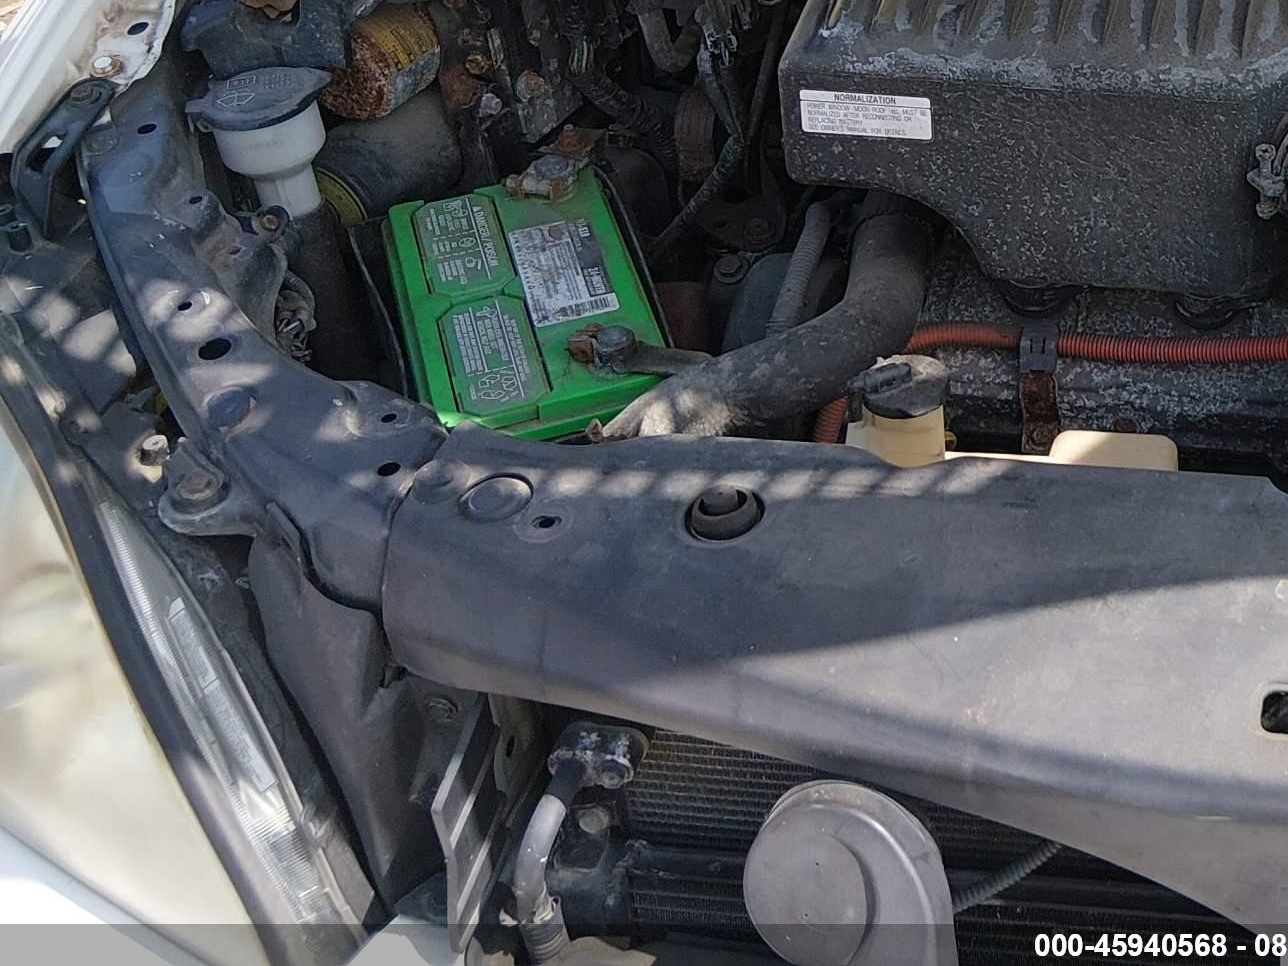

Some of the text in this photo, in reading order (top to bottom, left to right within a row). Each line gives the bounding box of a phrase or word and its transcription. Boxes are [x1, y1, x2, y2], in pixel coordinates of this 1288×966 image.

[834, 94, 897, 105] NORMALIZATION
[474, 211, 491, 238] DANGER
[483, 241, 500, 267] POISON
